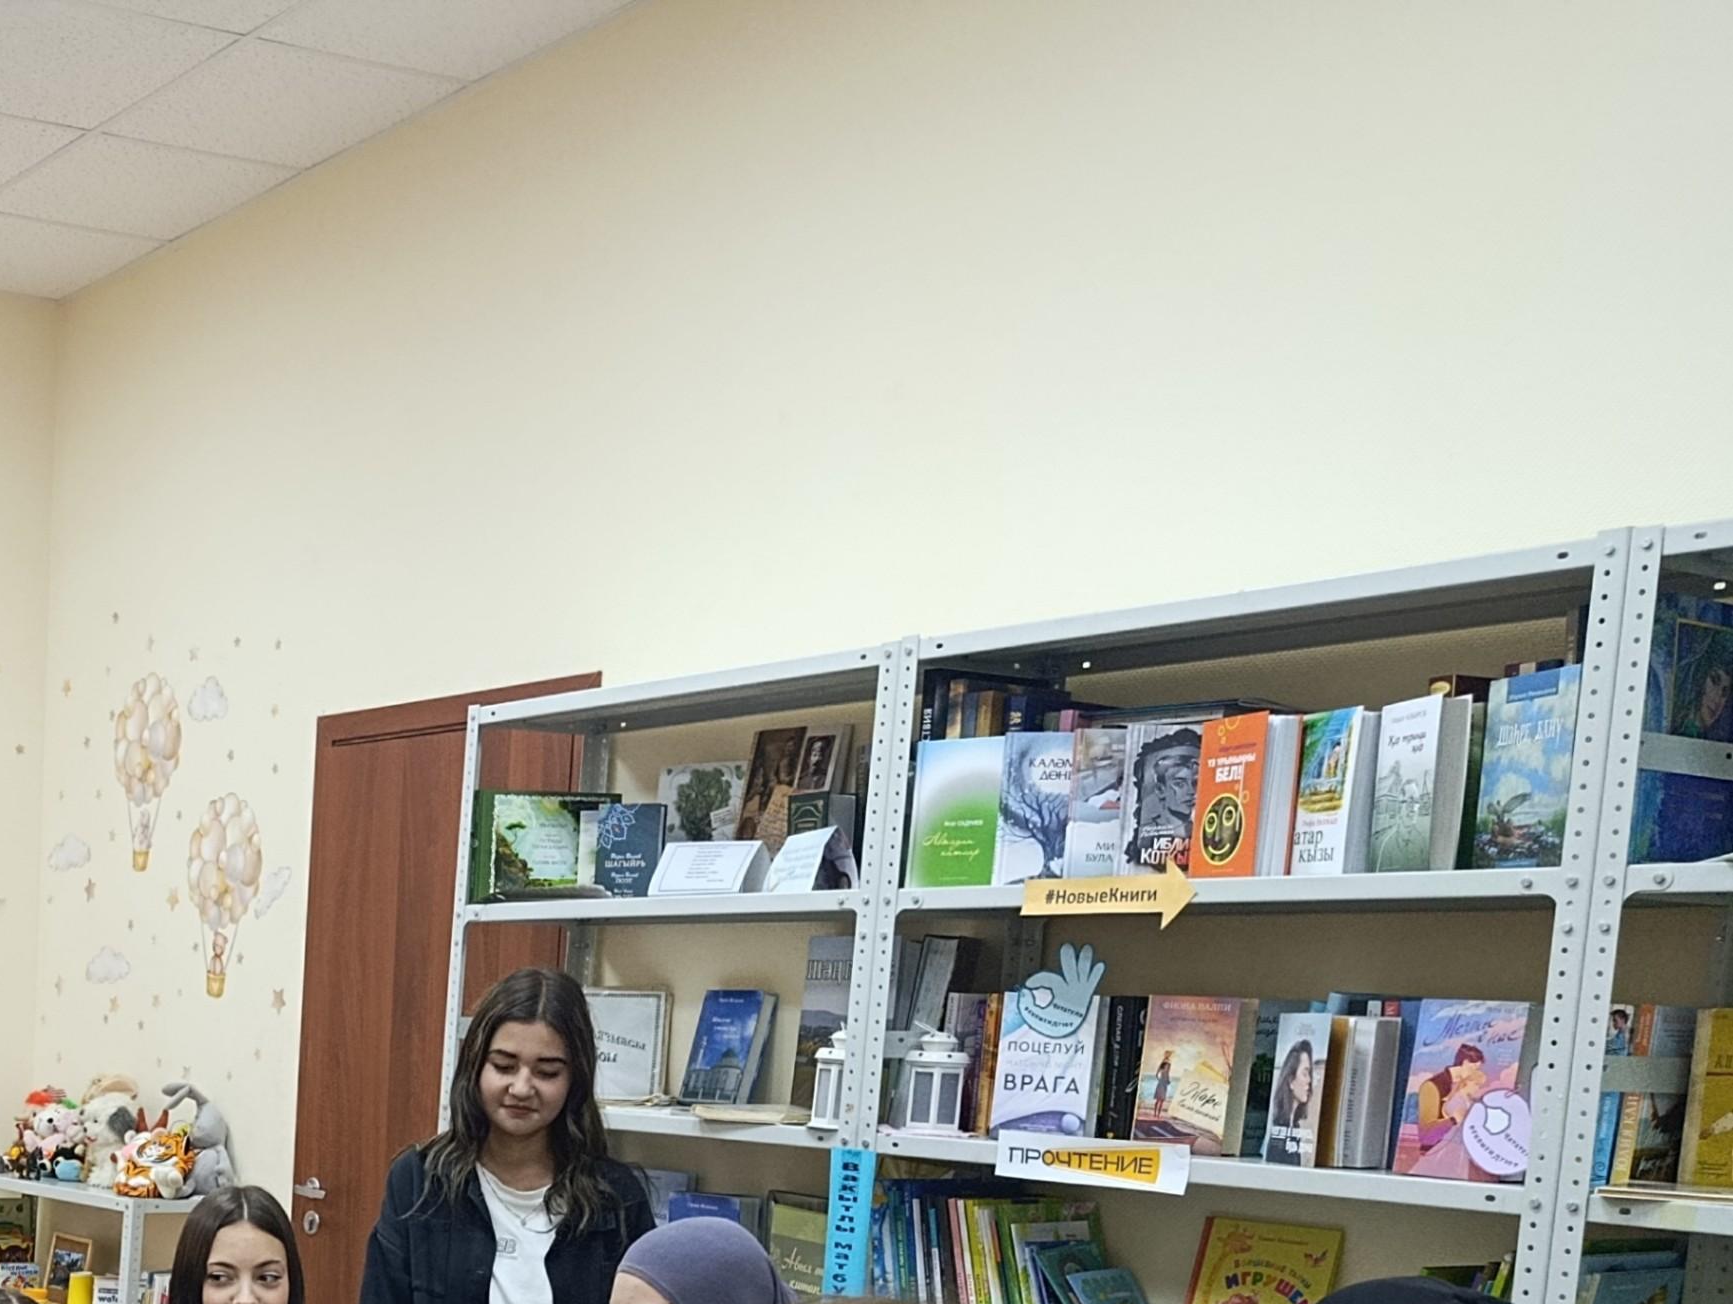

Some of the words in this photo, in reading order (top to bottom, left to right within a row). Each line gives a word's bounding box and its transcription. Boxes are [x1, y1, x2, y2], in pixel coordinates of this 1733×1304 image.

[1293, 830, 1323, 847] атар
[1045, 888, 1158, 905] #НовыеКниги
[1007, 1040, 1085, 1055] ПОЦЕЛУЙ
[1003, 1073, 1080, 1095] ВРАГА
[1008, 1147, 1154, 1174] ПРОЧТЕНИЕ
